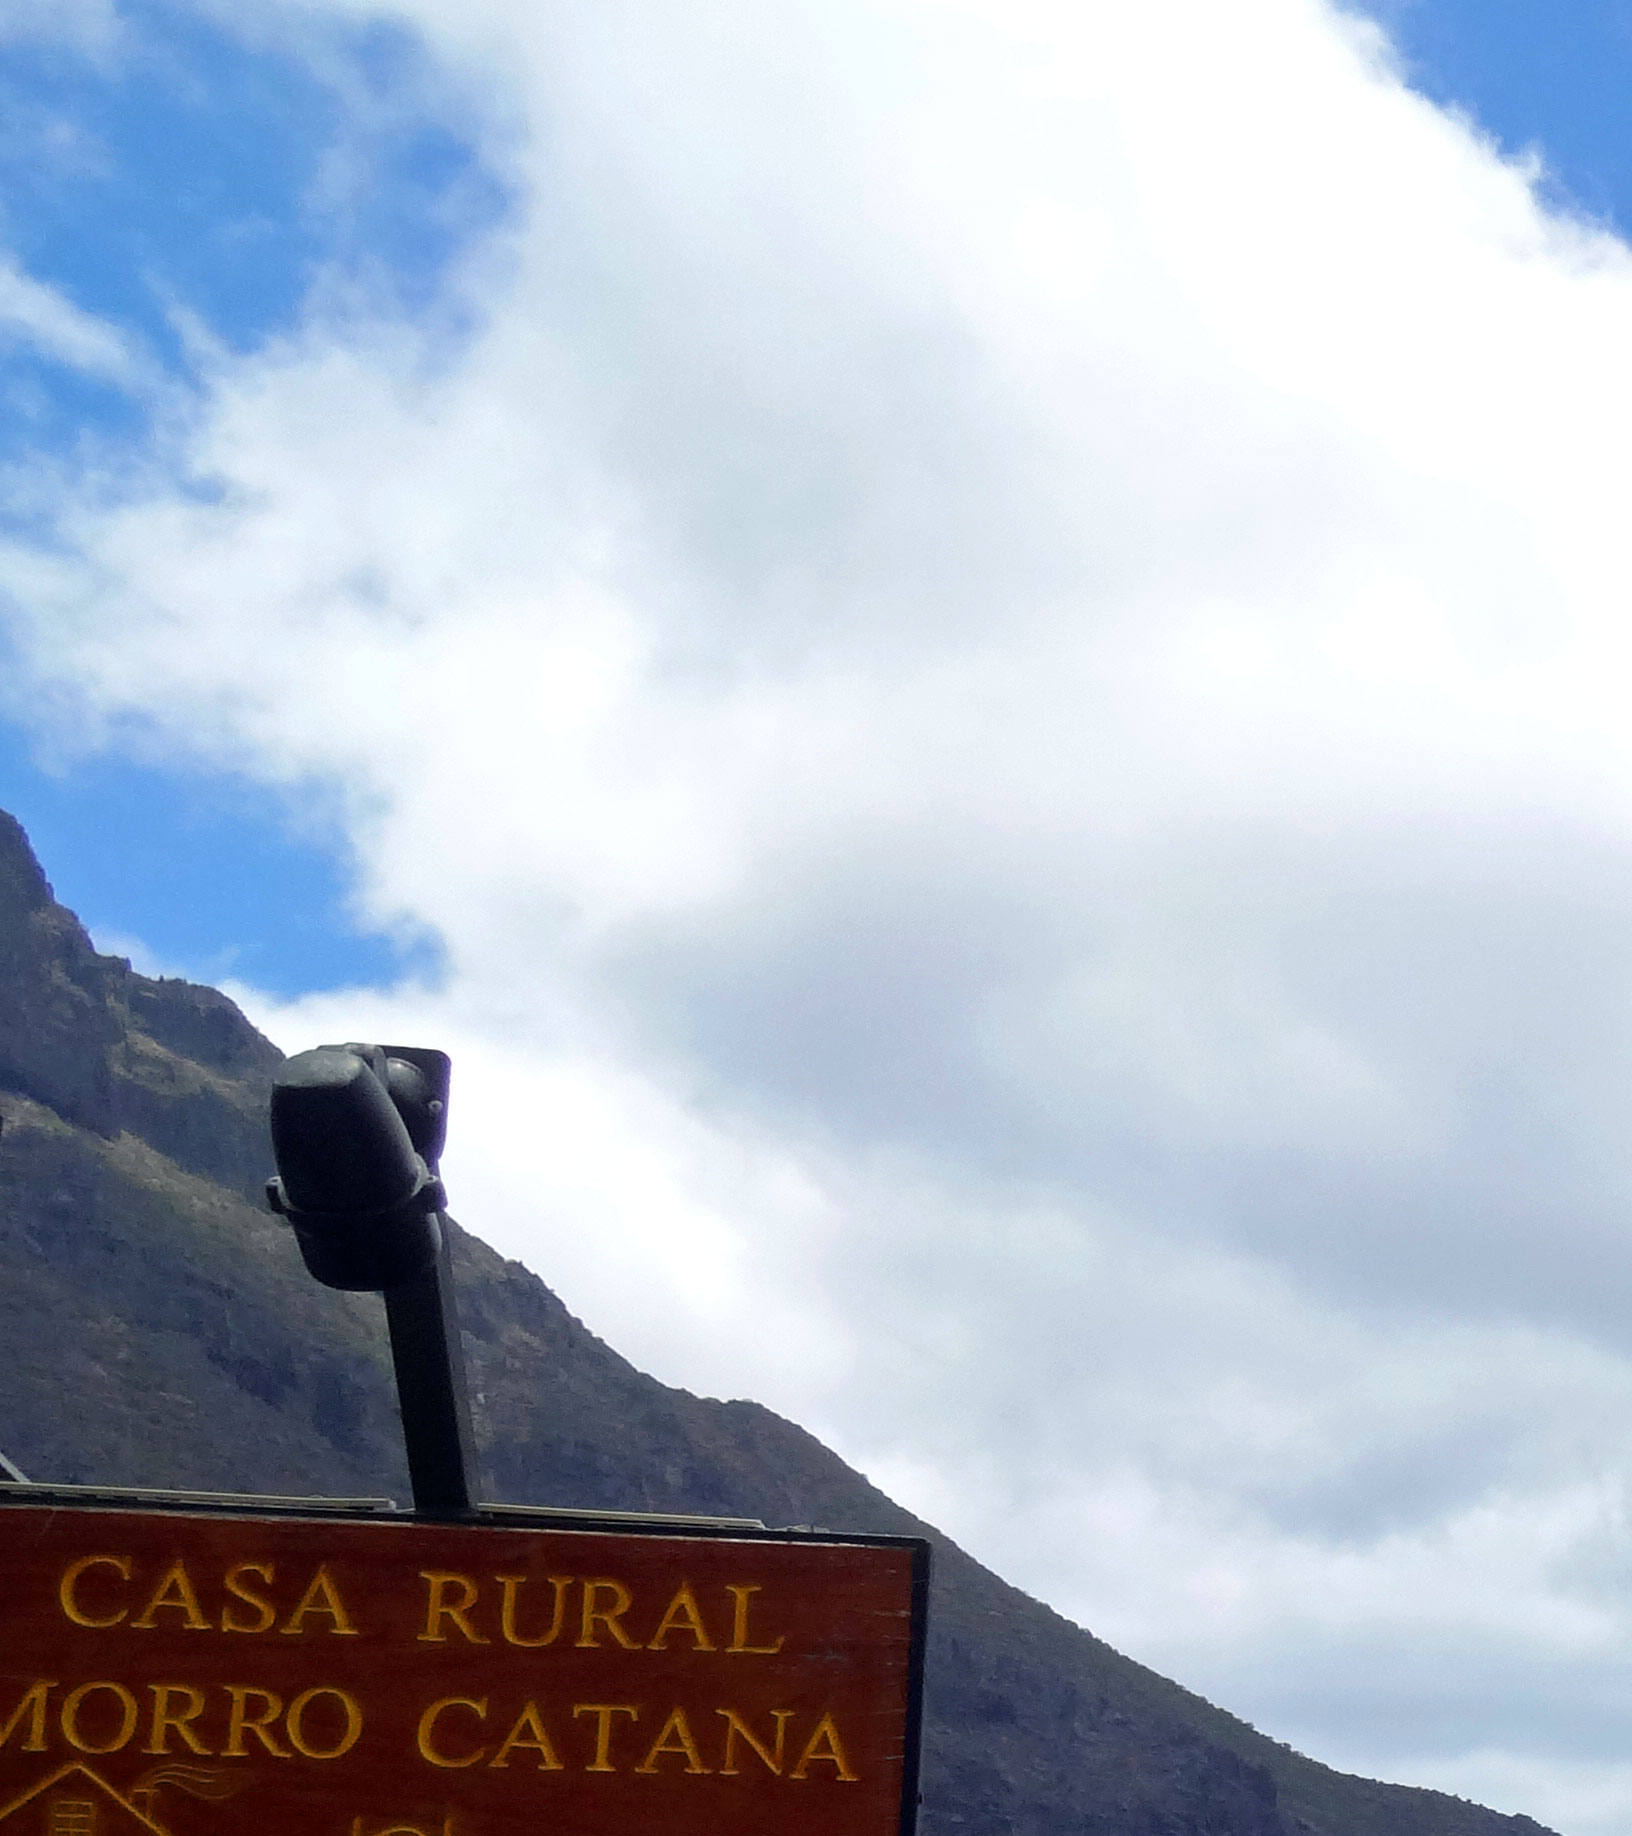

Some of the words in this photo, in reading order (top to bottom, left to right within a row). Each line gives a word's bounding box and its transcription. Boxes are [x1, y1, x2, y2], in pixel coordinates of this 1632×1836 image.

[60, 1555, 359, 1635] CASA
[416, 1569, 786, 1654] RURAL
[416, 1697, 859, 1782] CATANA
